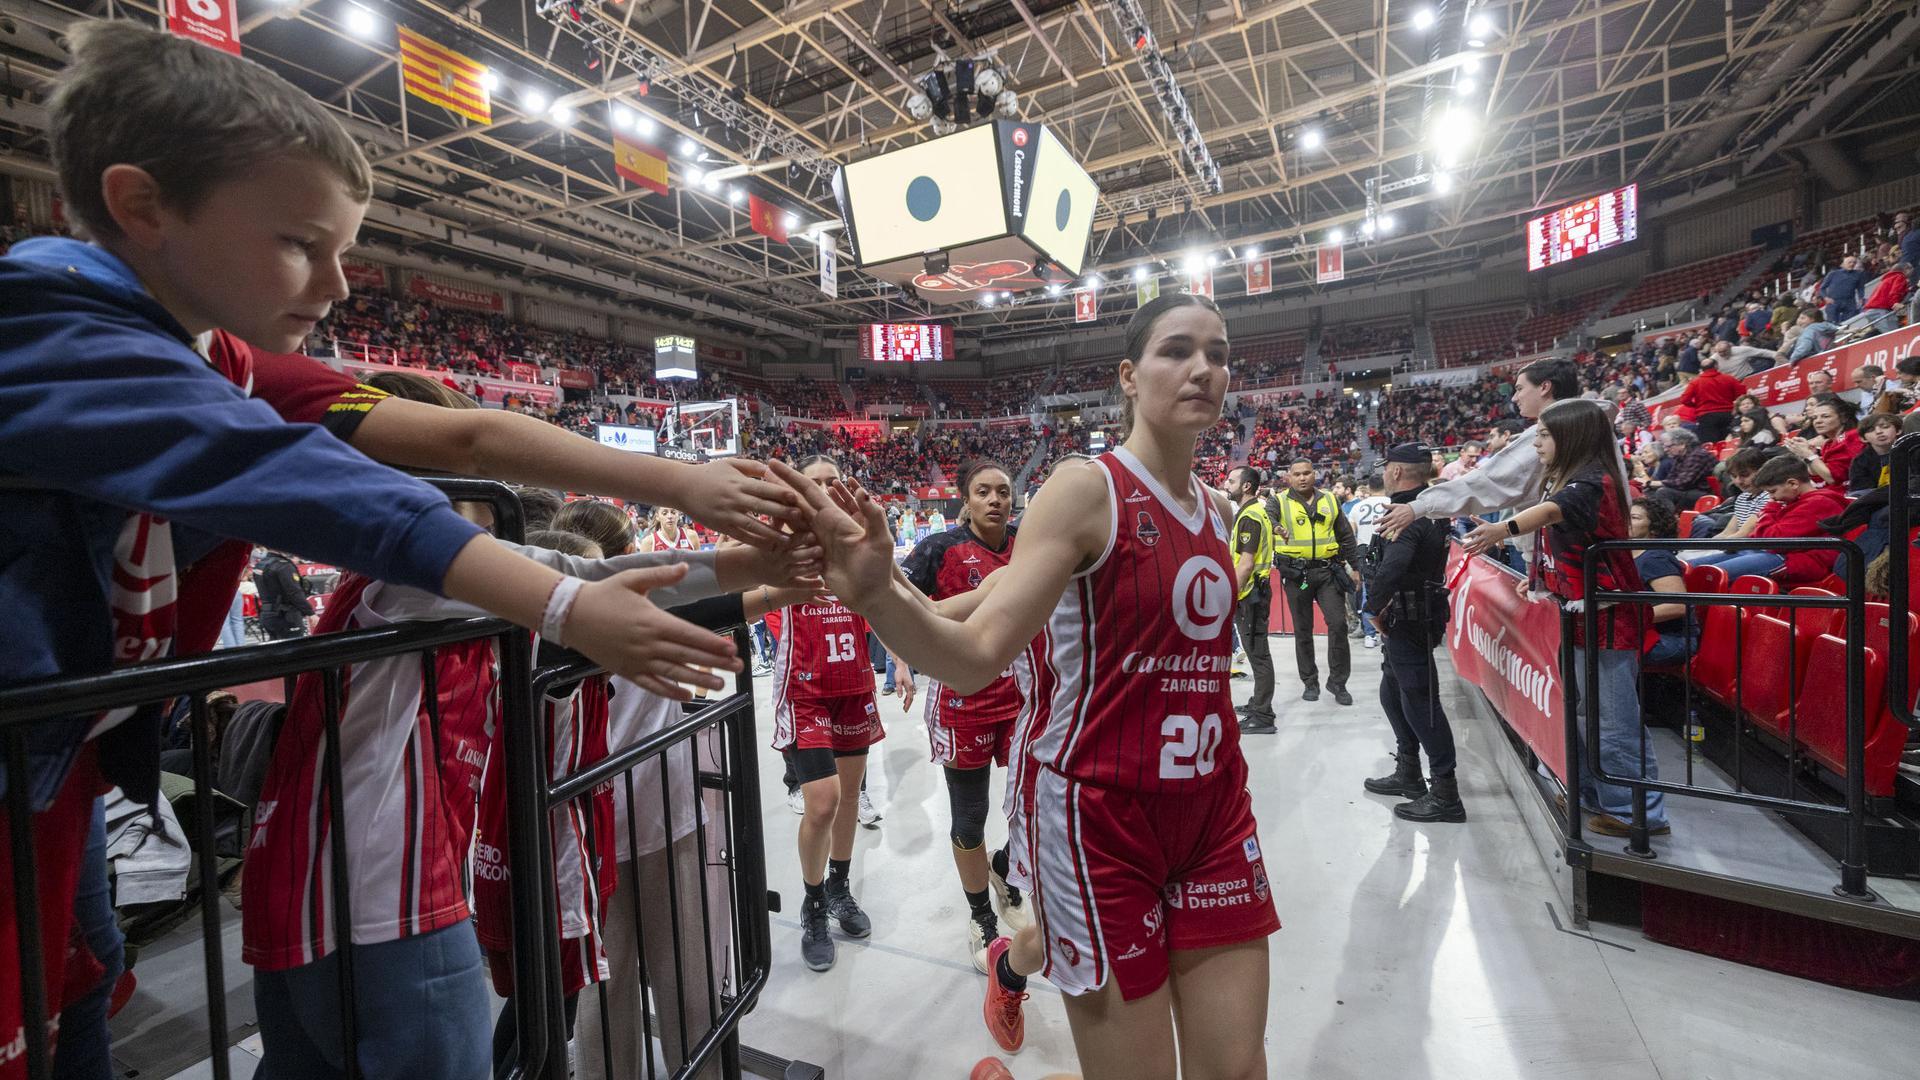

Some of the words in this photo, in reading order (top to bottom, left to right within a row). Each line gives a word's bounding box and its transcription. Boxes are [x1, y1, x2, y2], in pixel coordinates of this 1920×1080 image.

[1013, 149, 1026, 218] Casademont
[664, 448, 698, 461] endesa
[824, 632, 857, 663] 13
[1466, 604, 1556, 719] Casademont
[1159, 713, 1222, 779] 20
[1185, 878, 1249, 896] Zaragoza
[1187, 892, 1251, 911] DEPORTE
